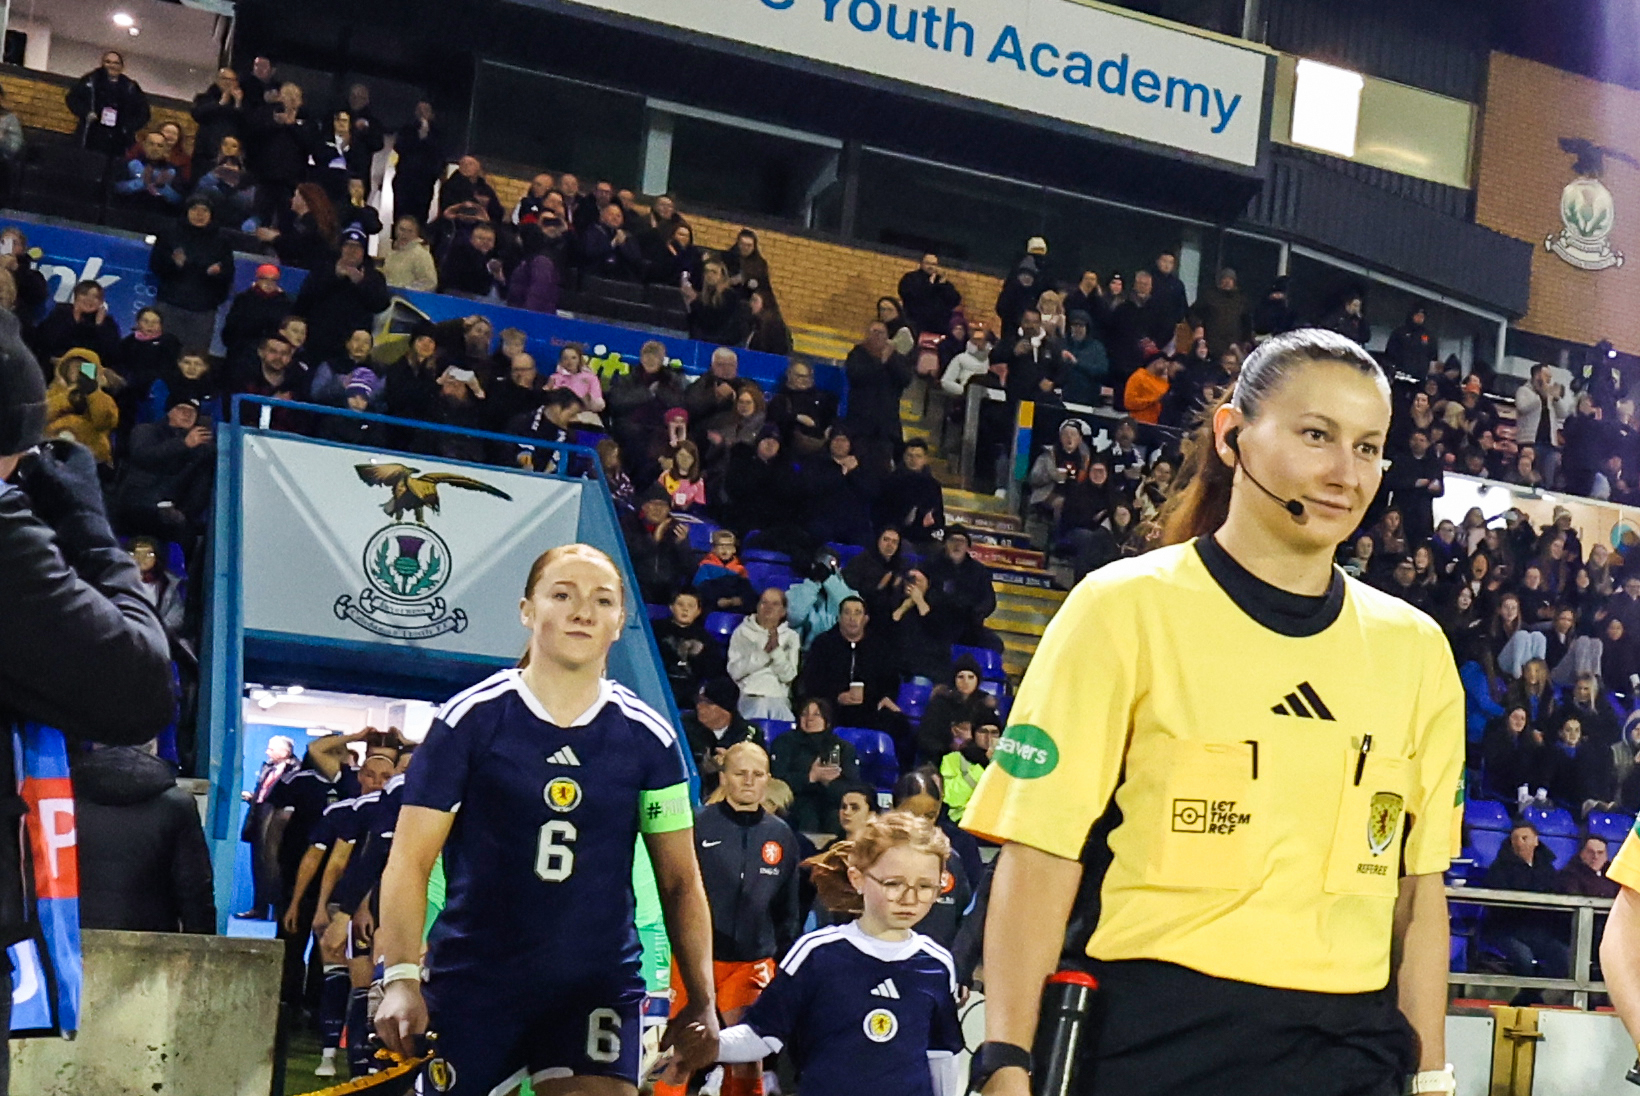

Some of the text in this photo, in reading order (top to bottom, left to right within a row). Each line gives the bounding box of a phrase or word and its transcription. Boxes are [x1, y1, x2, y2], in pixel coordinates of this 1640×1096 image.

[822, 0, 1242, 134] Youth Academy
[1210, 812, 1251, 824] THEM
[1211, 800, 1236, 812] LET
[1208, 824, 1236, 835] REF
[533, 819, 578, 883] 6
[586, 1007, 624, 1064] 6
